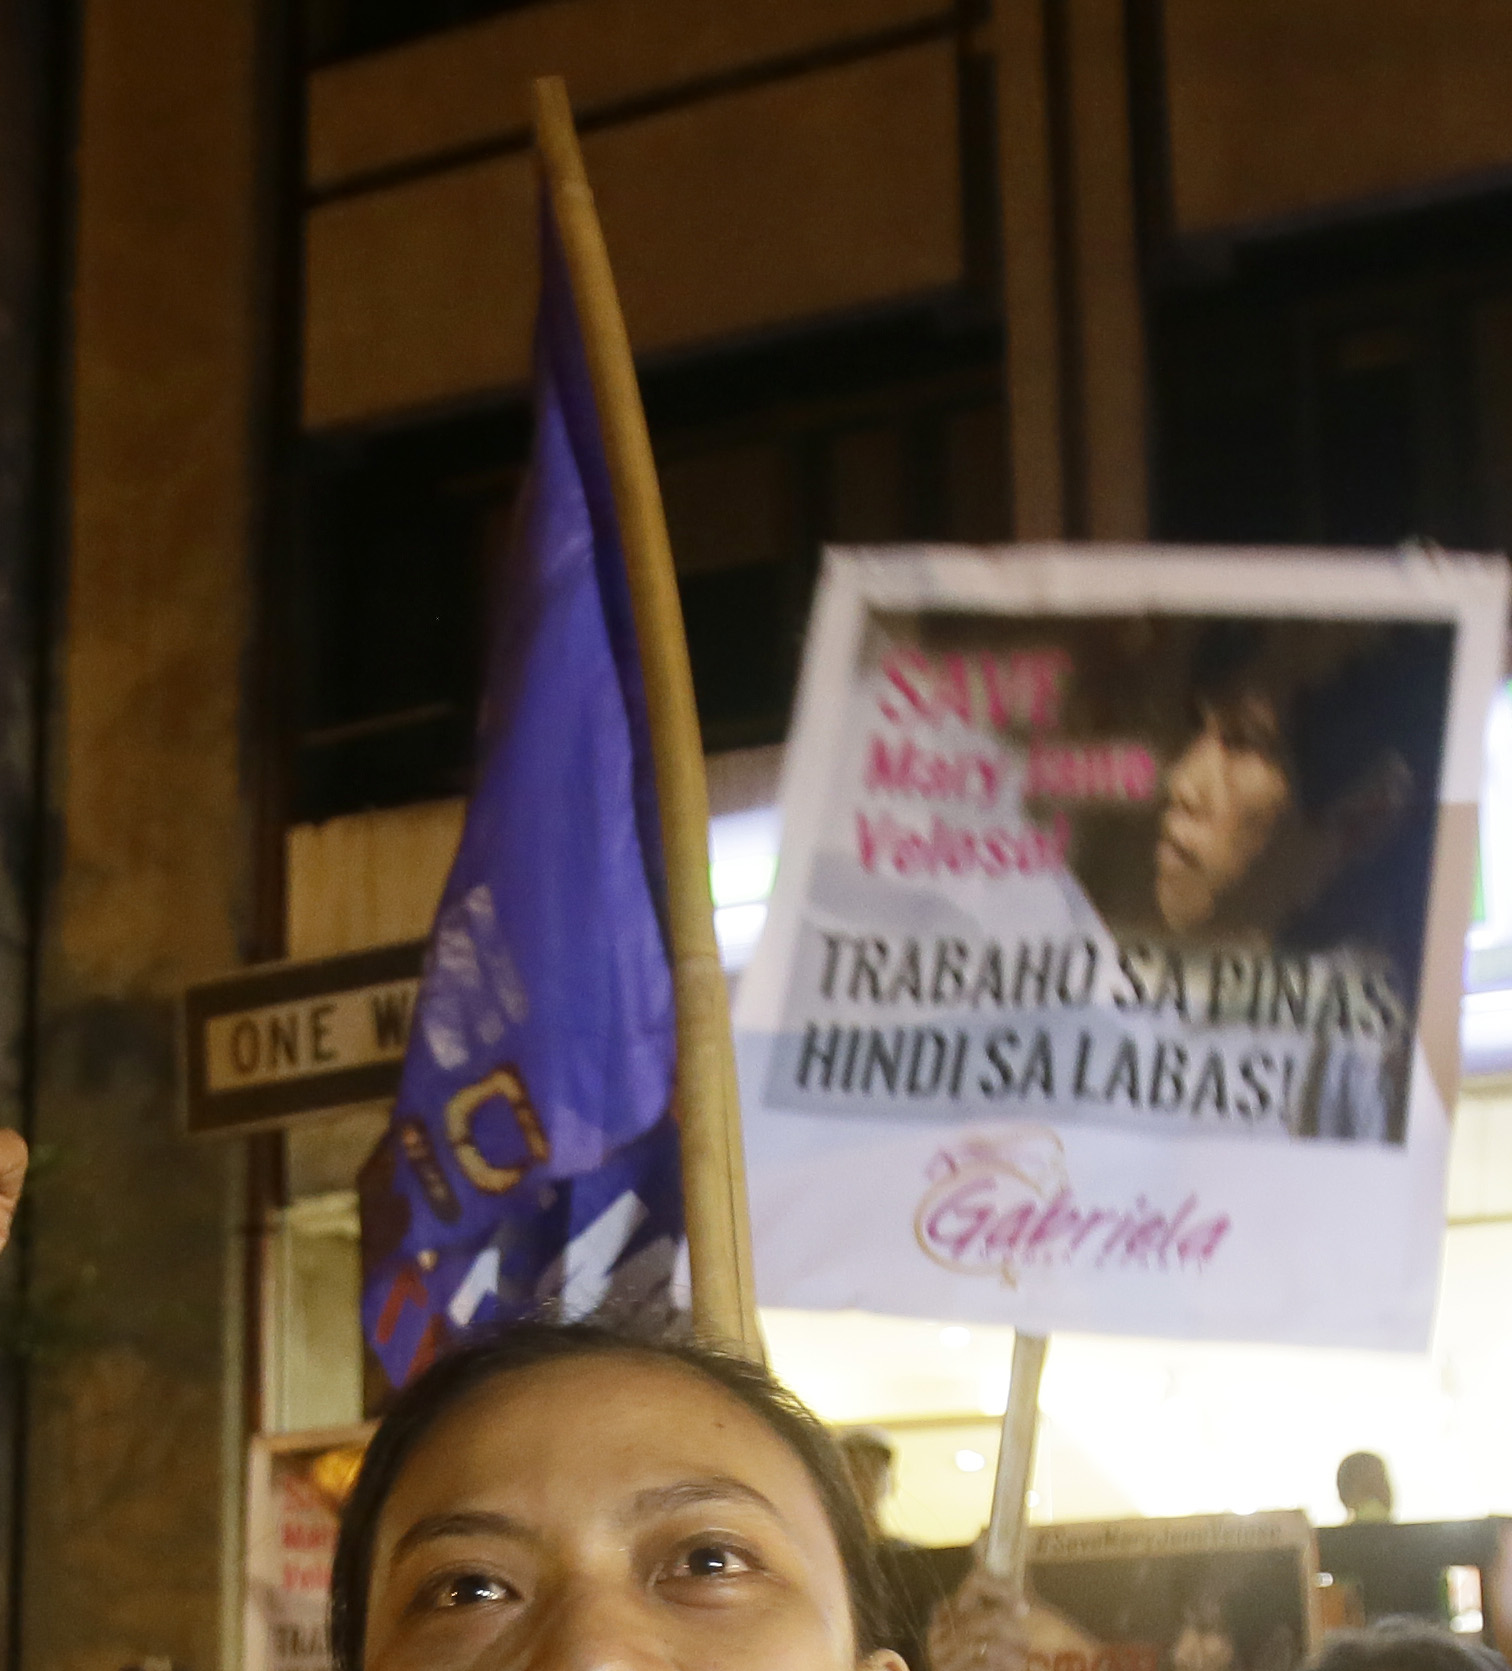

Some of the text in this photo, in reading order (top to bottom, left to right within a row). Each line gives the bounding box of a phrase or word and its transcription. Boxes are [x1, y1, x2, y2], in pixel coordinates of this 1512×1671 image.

[820, 932, 1400, 1038] TRABAHO SA PINAS
[229, 1004, 336, 1078] ONE
[796, 1022, 968, 1098] HINDI
[980, 1026, 1056, 1102] SA
[926, 1178, 1233, 1268] Gabriela
